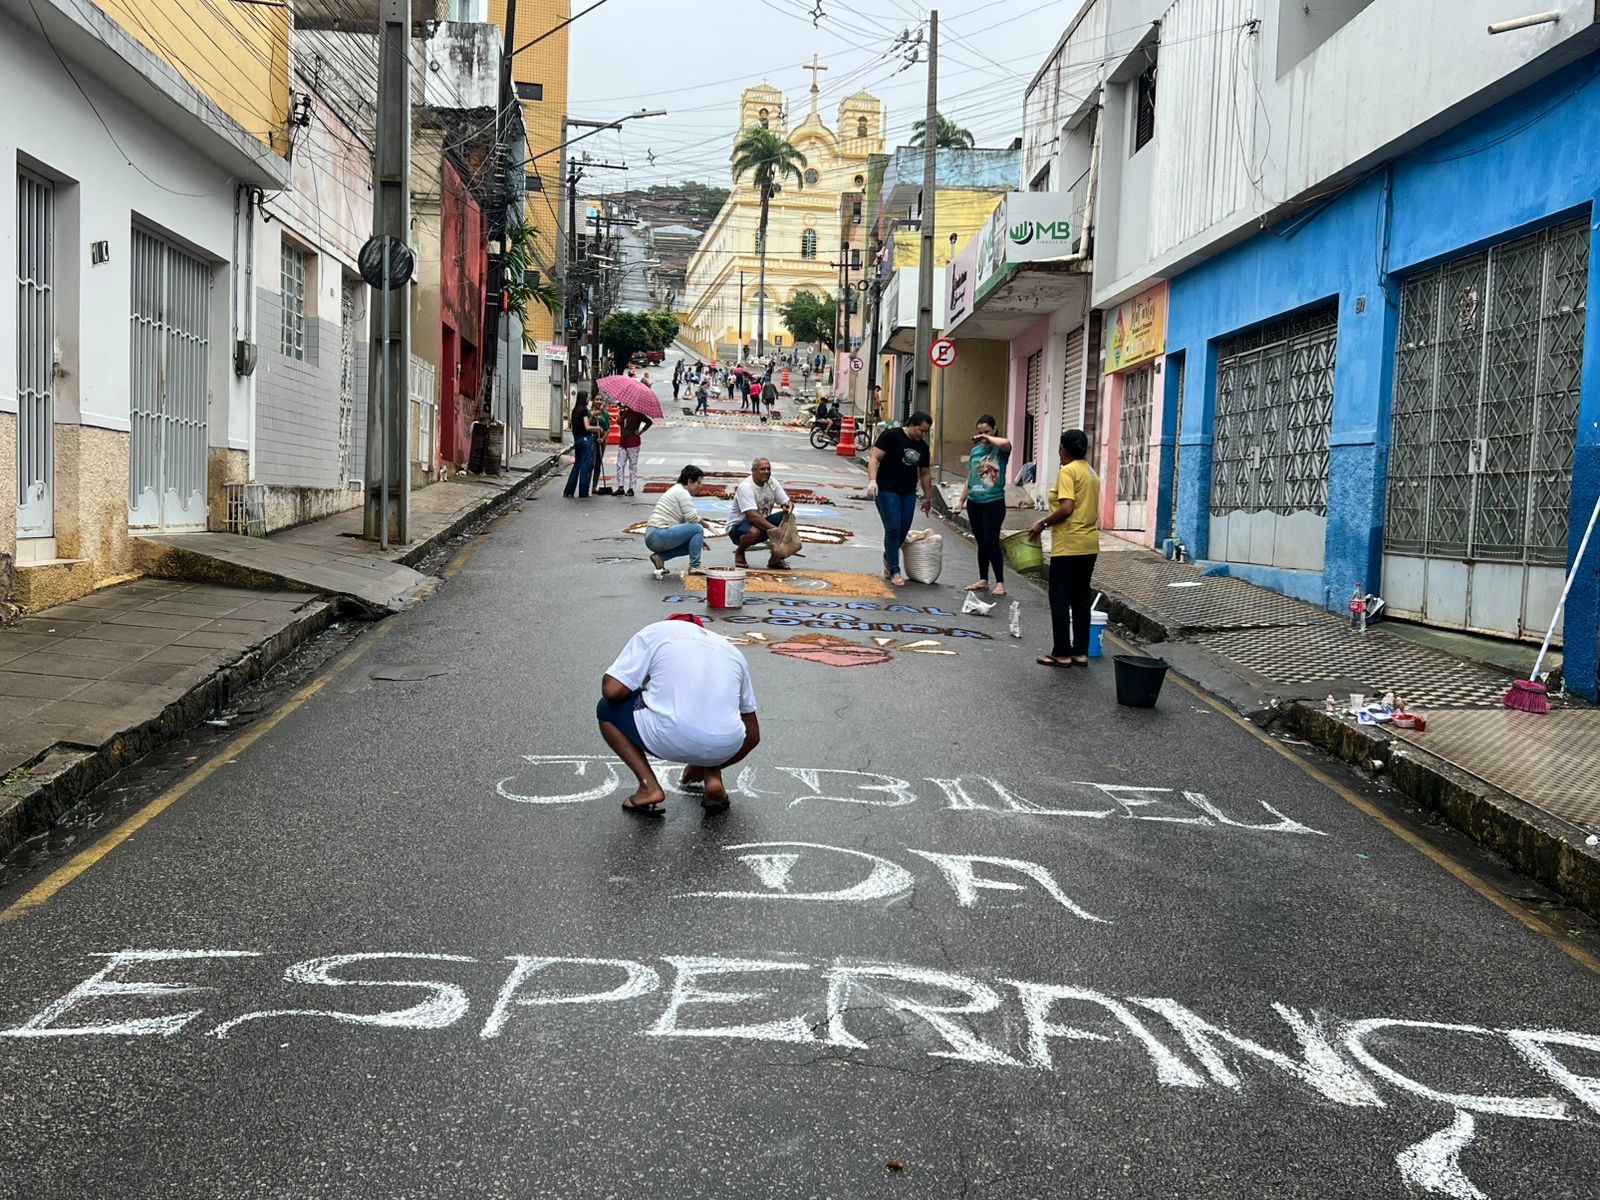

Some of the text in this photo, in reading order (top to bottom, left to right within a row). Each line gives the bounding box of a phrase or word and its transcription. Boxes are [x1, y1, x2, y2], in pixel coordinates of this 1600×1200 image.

[1035, 221, 1070, 240] MB
[939, 346, 948, 361] E
[662, 594, 957, 617] PSTORAL
[767, 608, 861, 622] DA
[496, 754, 1328, 836] JUBILEU
[668, 842, 1114, 923] DA
